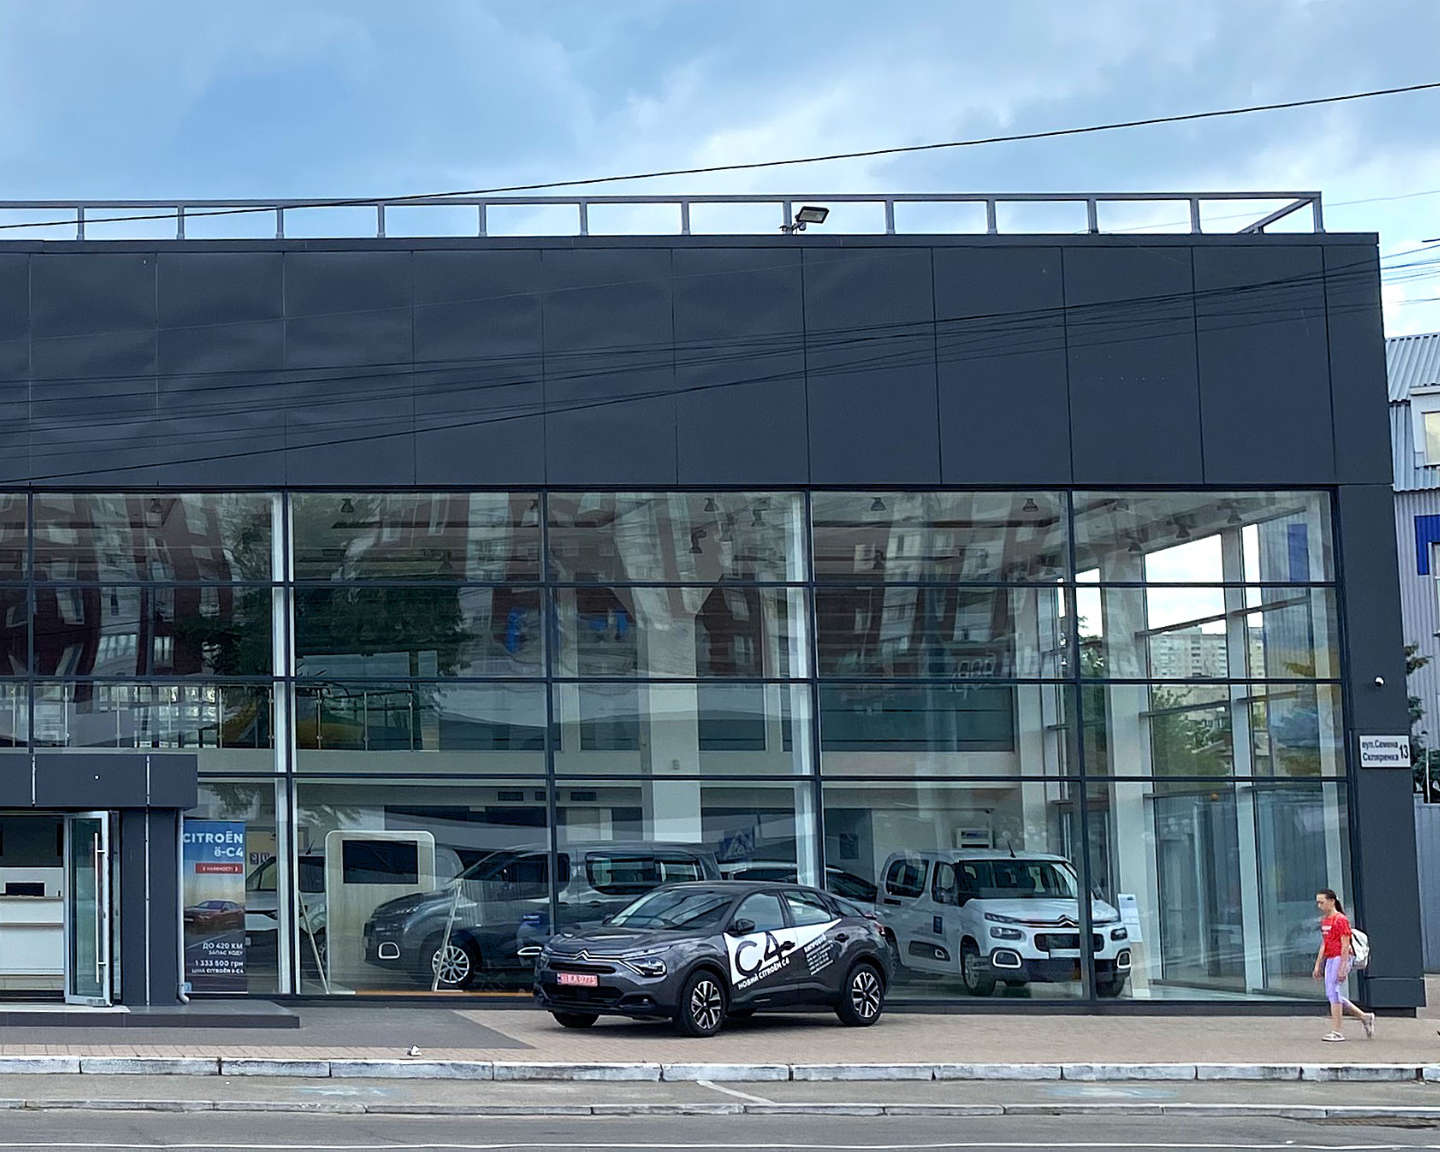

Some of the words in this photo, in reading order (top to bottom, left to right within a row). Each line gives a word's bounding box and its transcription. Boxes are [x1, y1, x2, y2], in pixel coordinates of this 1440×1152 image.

[1400, 744, 1409, 760] 13
[183, 830, 243, 844] CITROËN
[735, 930, 781, 978] C4
